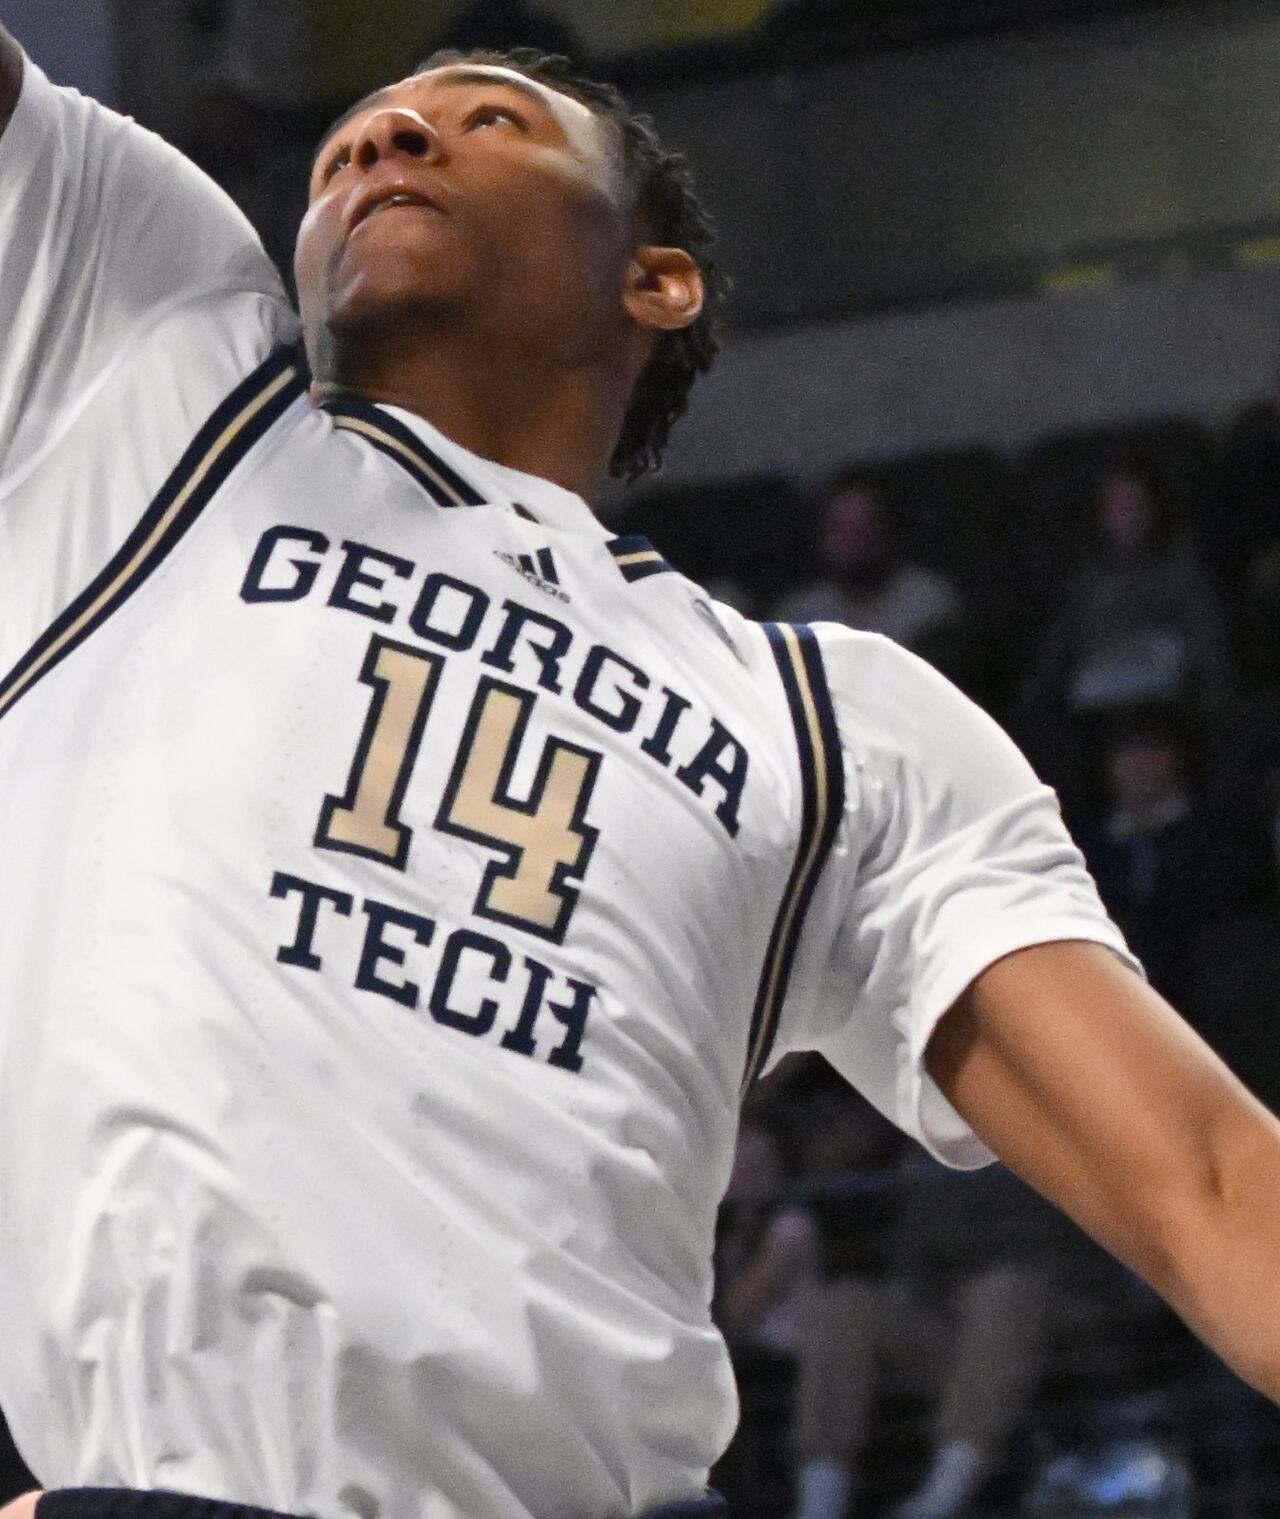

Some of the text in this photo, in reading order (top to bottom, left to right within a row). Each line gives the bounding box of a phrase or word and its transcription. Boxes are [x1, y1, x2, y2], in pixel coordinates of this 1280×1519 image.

[239, 524, 751, 840] GEORGIA
[312, 632, 604, 945] 14
[269, 871, 598, 1073] TECH
